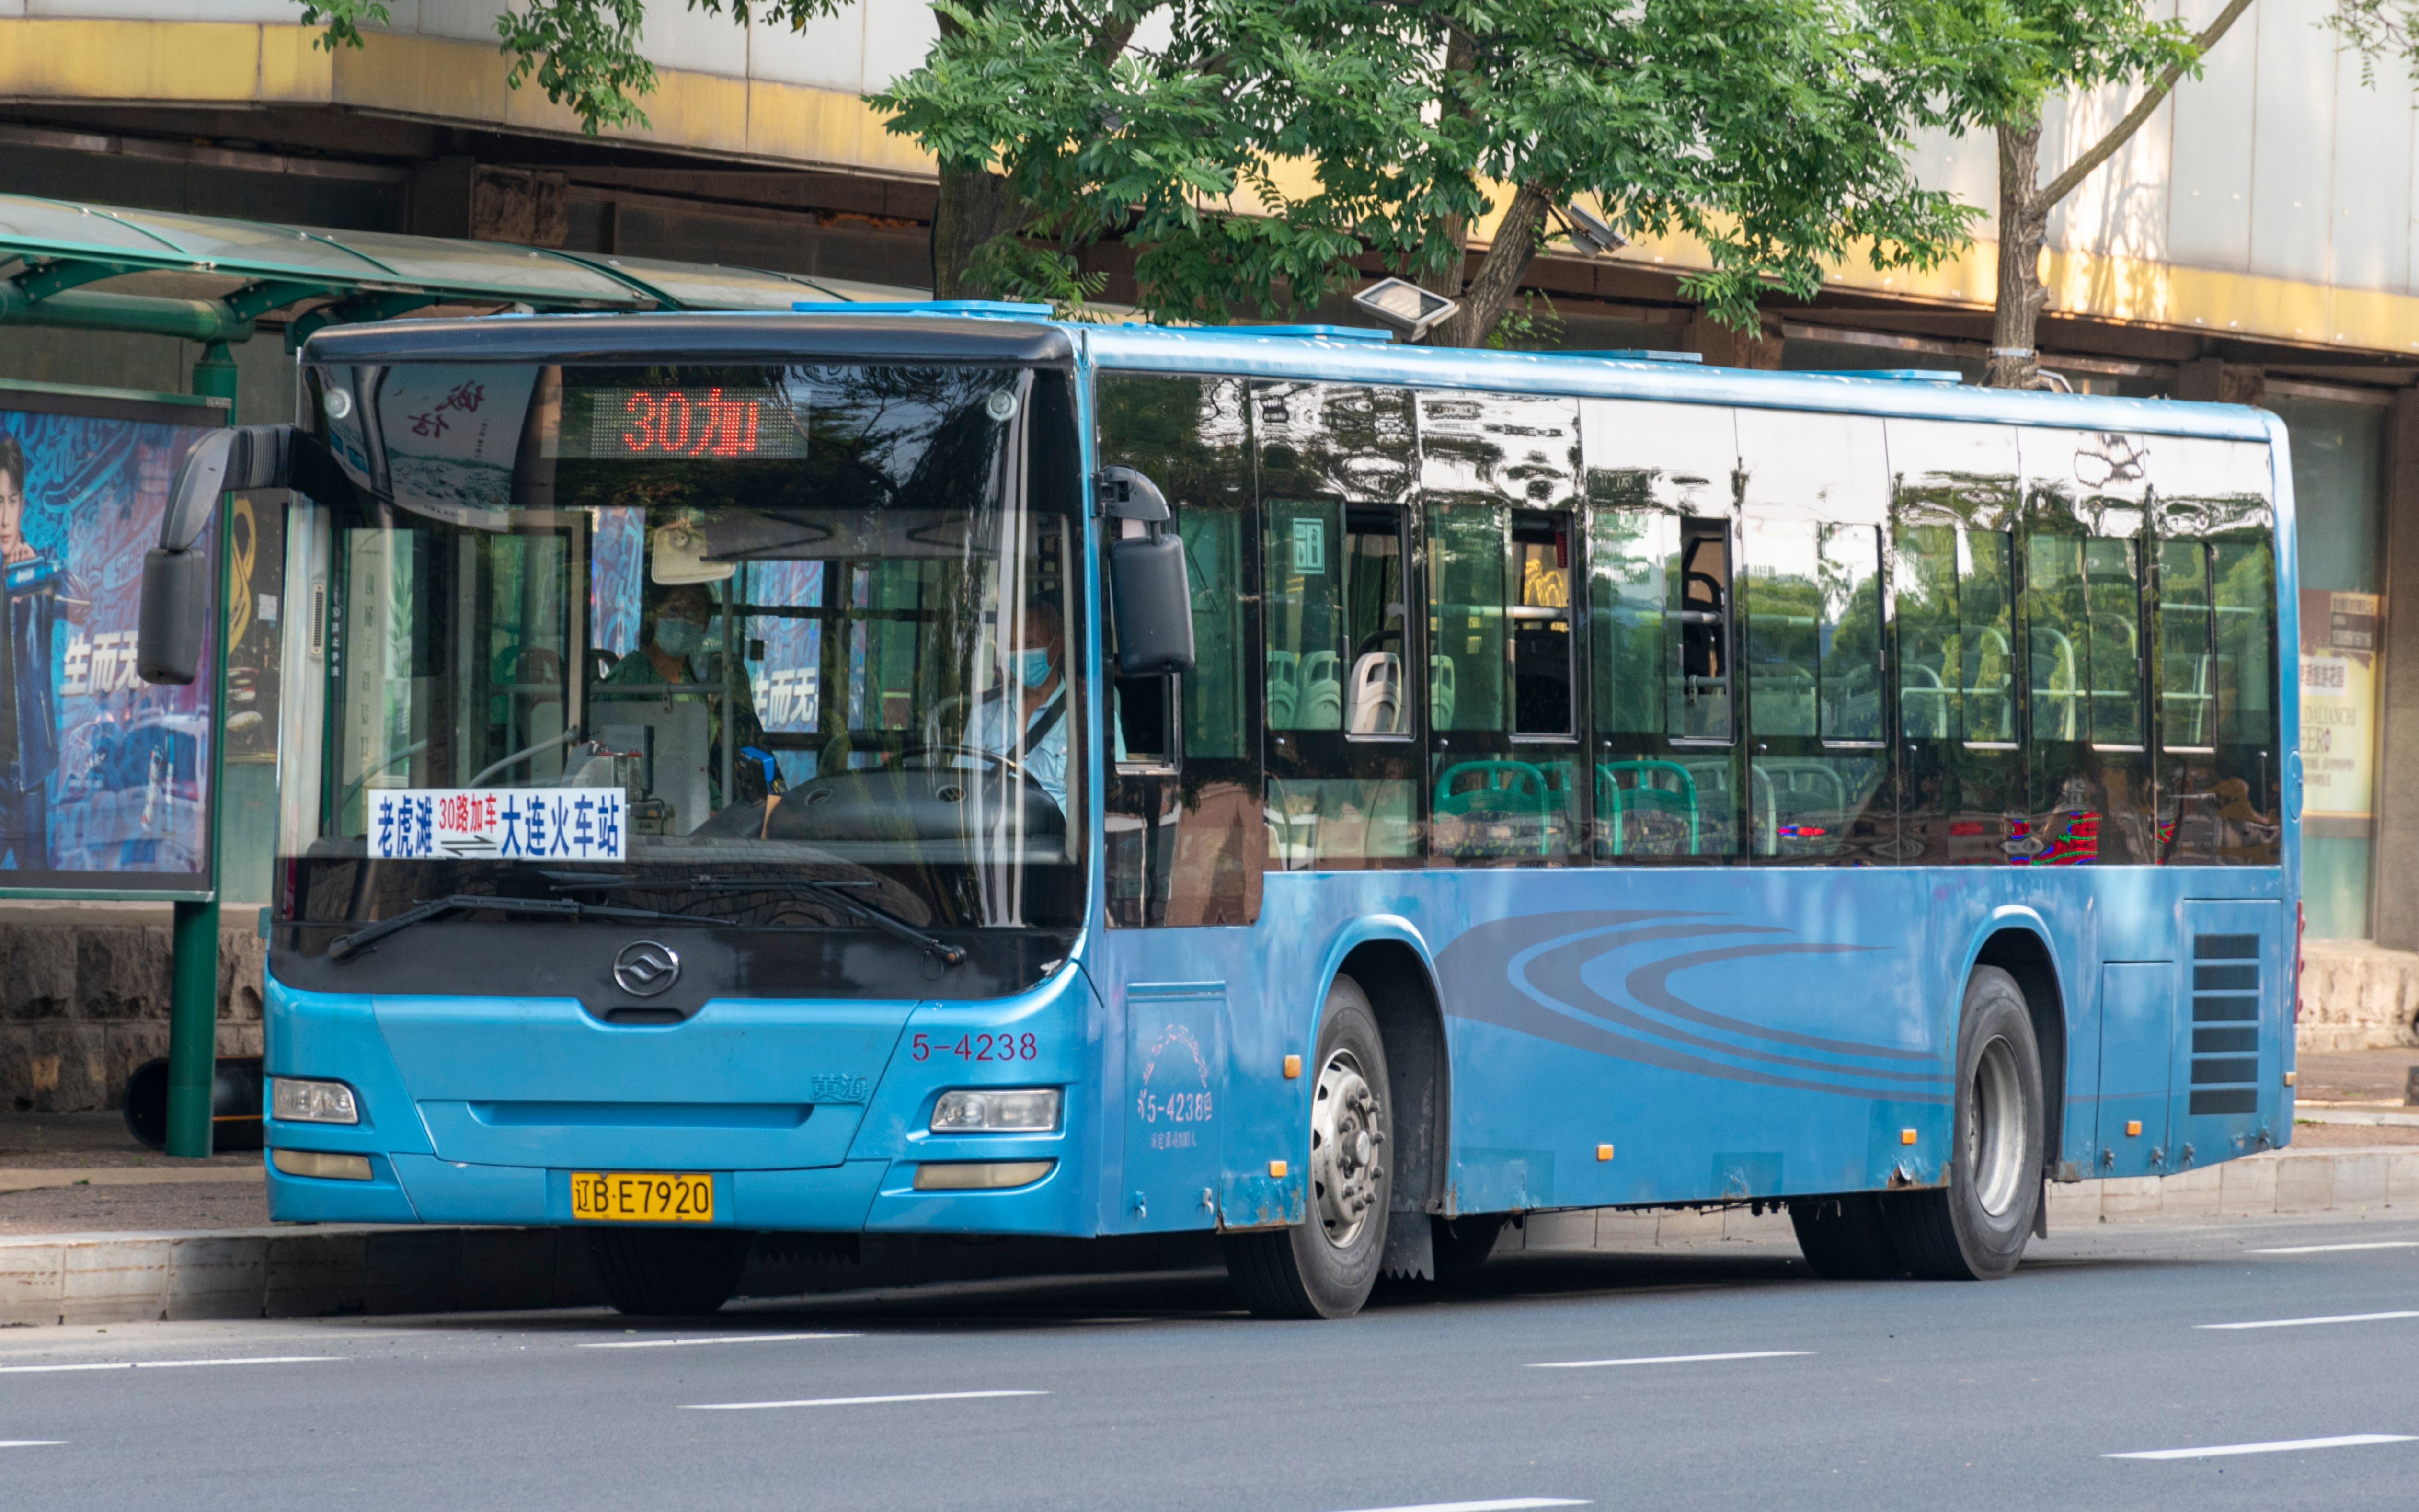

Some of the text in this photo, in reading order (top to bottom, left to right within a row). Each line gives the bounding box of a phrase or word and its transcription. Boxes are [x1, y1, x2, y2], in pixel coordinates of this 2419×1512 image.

[59, 630, 150, 696] 生而无
[755, 667, 819, 727] 生而无
[378, 793, 619, 858] 老虎滩 30路加车 大连火车站
[912, 1032, 1037, 1061] 5-4238
[811, 1073, 868, 1101] 黄海
